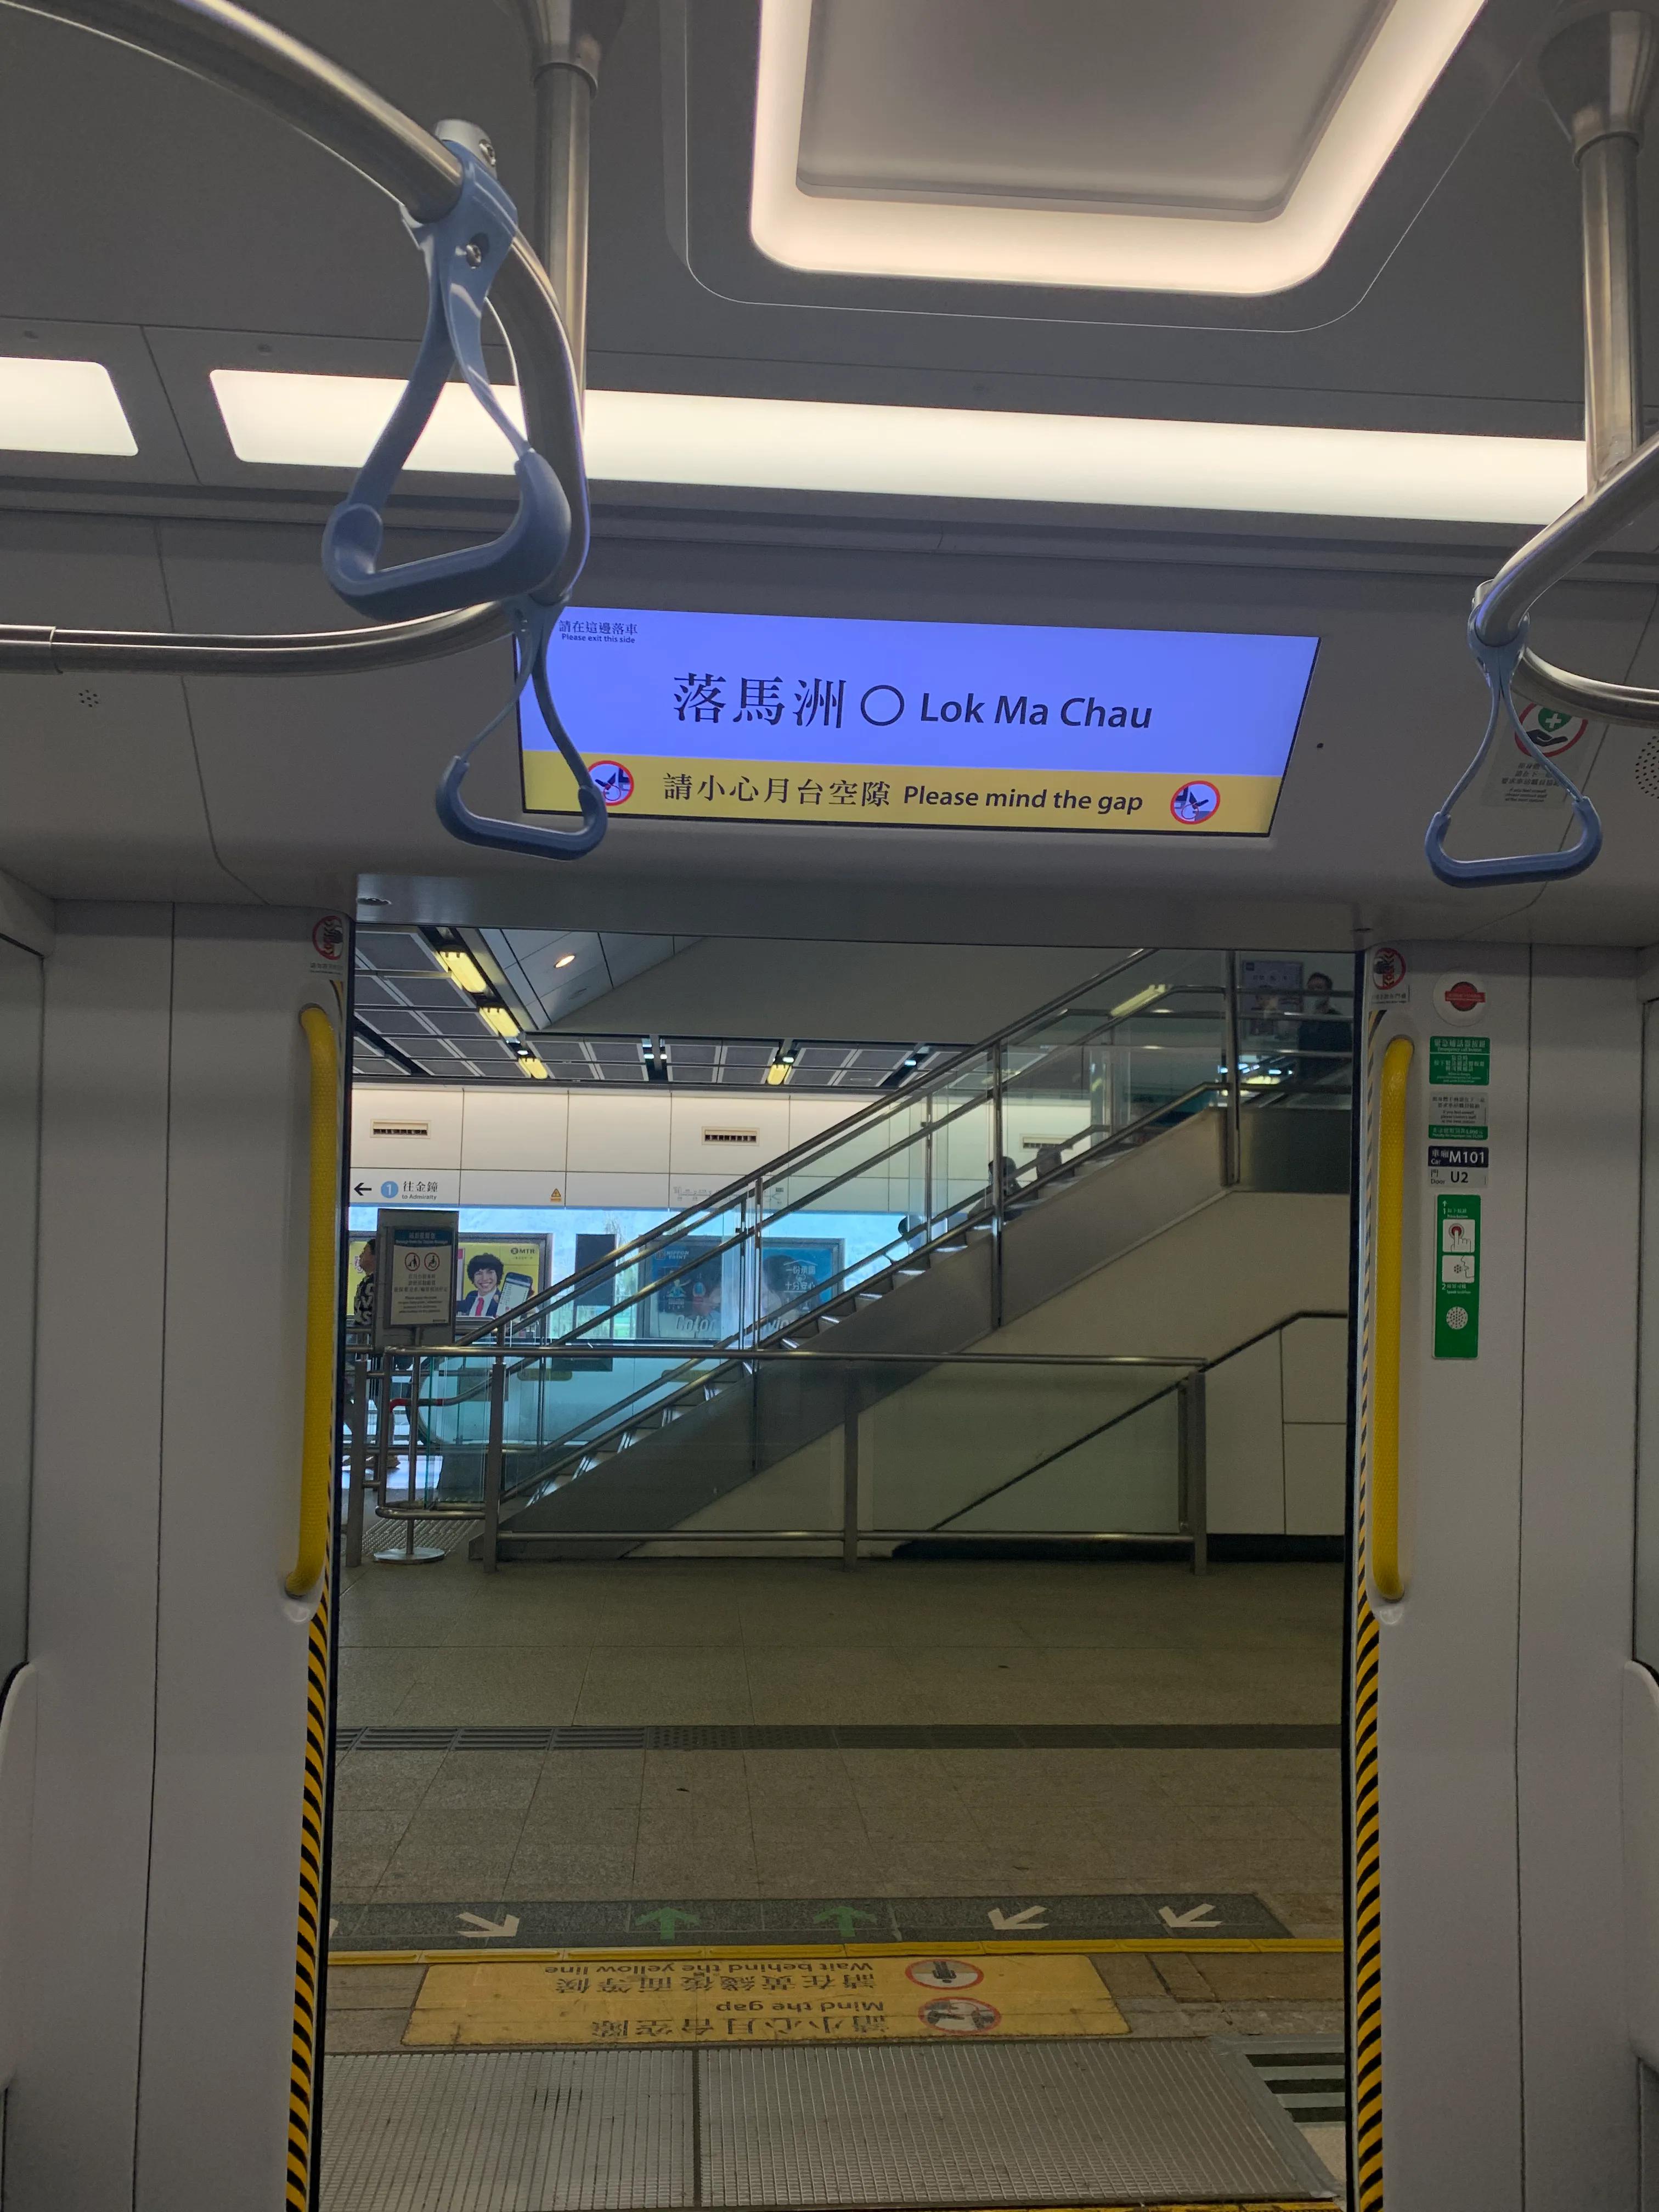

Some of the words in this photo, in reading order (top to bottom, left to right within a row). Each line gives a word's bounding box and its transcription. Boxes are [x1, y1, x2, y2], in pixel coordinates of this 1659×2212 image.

[558, 620, 638, 635] 請在這邊落車
[674, 673, 847, 729] 落馬洲
[921, 693, 986, 723] Lok
[994, 695, 1048, 725] Ma
[1060, 697, 1152, 729] Chau
[663, 772, 890, 807] 請小心月台空隙
[904, 785, 979, 806] Please
[985, 788, 1047, 808] mind
[1053, 789, 1092, 809] the
[1097, 794, 1143, 815] gap
[1449, 1151, 1484, 1163] M101
[1451, 1171, 1469, 1183] U2
[545, 1966, 589, 1975] line
[596, 1962, 675, 1974] yellow
[682, 1964, 721, 1973] the
[729, 1963, 813, 1973] behind
[820, 1962, 873, 1971] Wait
[716, 2000, 764, 2011] gap
[772, 2002, 812, 2012] the
[821, 2001, 883, 2012] Mind
[592, 2015, 889, 2037] 請小心月台空隙
